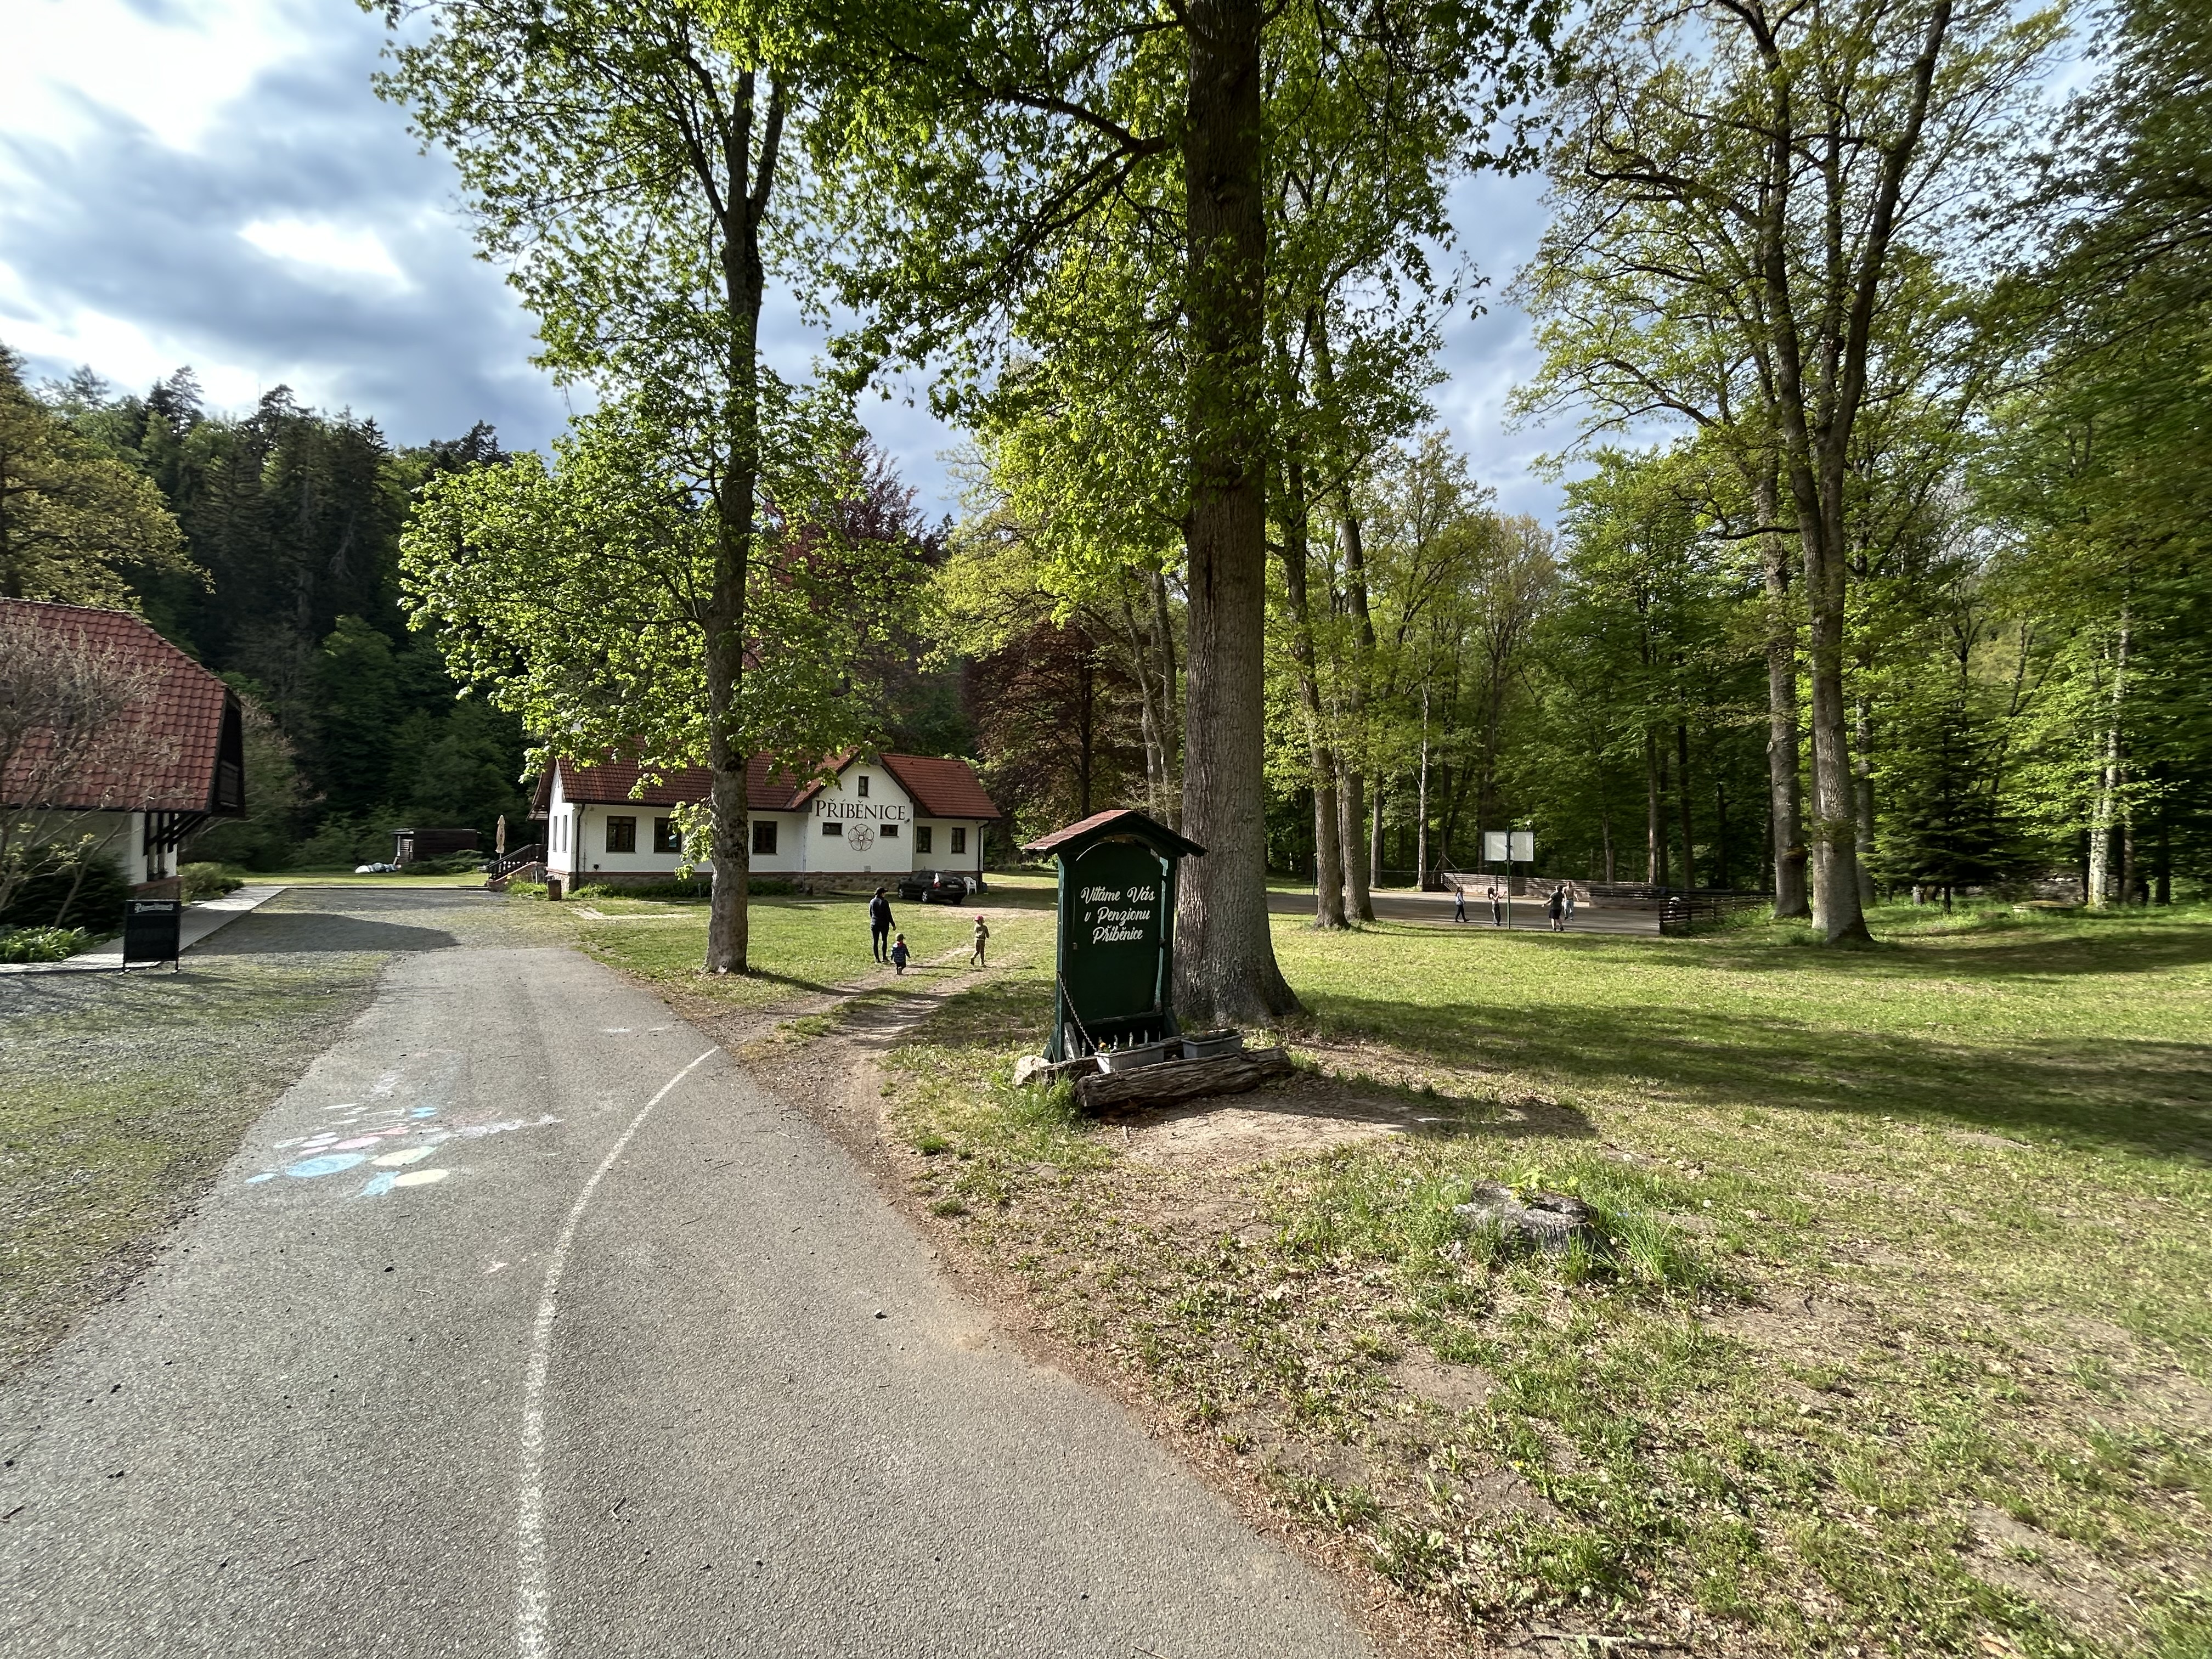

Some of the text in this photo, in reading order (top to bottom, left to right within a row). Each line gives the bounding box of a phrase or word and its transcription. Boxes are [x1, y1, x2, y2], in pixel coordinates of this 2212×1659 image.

[815, 798, 905, 820] PŘÍBĚNICE
[1127, 885, 1155, 903] Vás
[1084, 906, 1150, 926] v Penzionu
[1092, 924, 1143, 944] Příběnice
